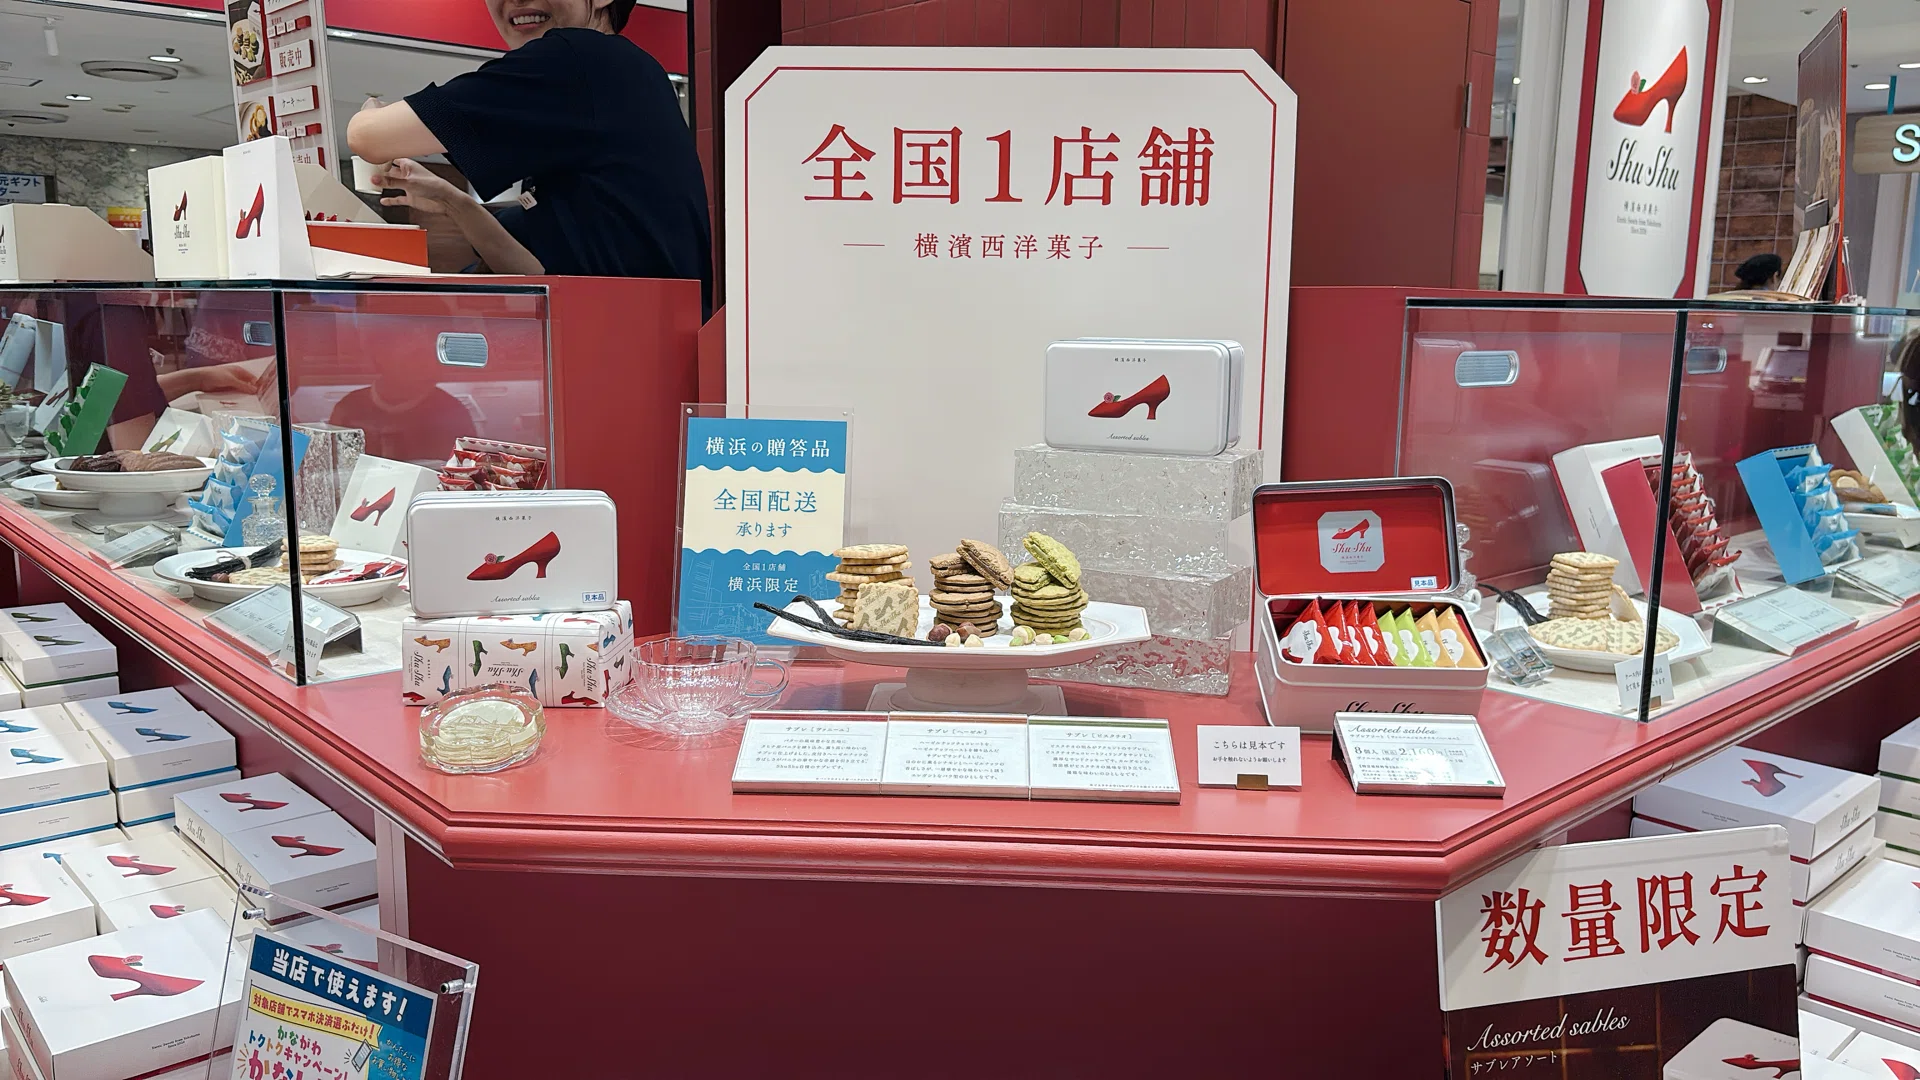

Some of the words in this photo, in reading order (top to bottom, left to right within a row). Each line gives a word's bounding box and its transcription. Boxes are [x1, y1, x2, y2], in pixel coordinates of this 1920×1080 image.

[278, 47, 302, 68] 販売中
[1893, 124, 1920, 162] S
[800, 123, 1215, 207] 全国1店舗
[1606, 138, 1643, 185] Shu
[1644, 146, 1679, 190] Shu
[913, 232, 1104, 260] 横濱西洋菓子
[705, 436, 830, 458] 横浜の贈答品
[713, 488, 818, 513] 全国配送
[736, 522, 793, 538] 承ります
[743, 562, 786, 572] 全国1店舗
[728, 576, 799, 593] 横浜限定
[1414, 579, 1434, 587] 見本品
[584, 593, 605, 602] 見本品
[1348, 725, 1401, 733] Assorted
[1402, 727, 1438, 735] sables
[1213, 740, 1286, 750] こちらは見本です
[1480, 864, 1771, 974] 数量限定
[271, 948, 408, 1022] 当店で使えます!
[277, 1025, 322, 1056] かながわ
[1467, 1013, 1568, 1051] Assorted
[1569, 1007, 1630, 1036] sables
[1471, 1051, 1557, 1075] サブレアソート
